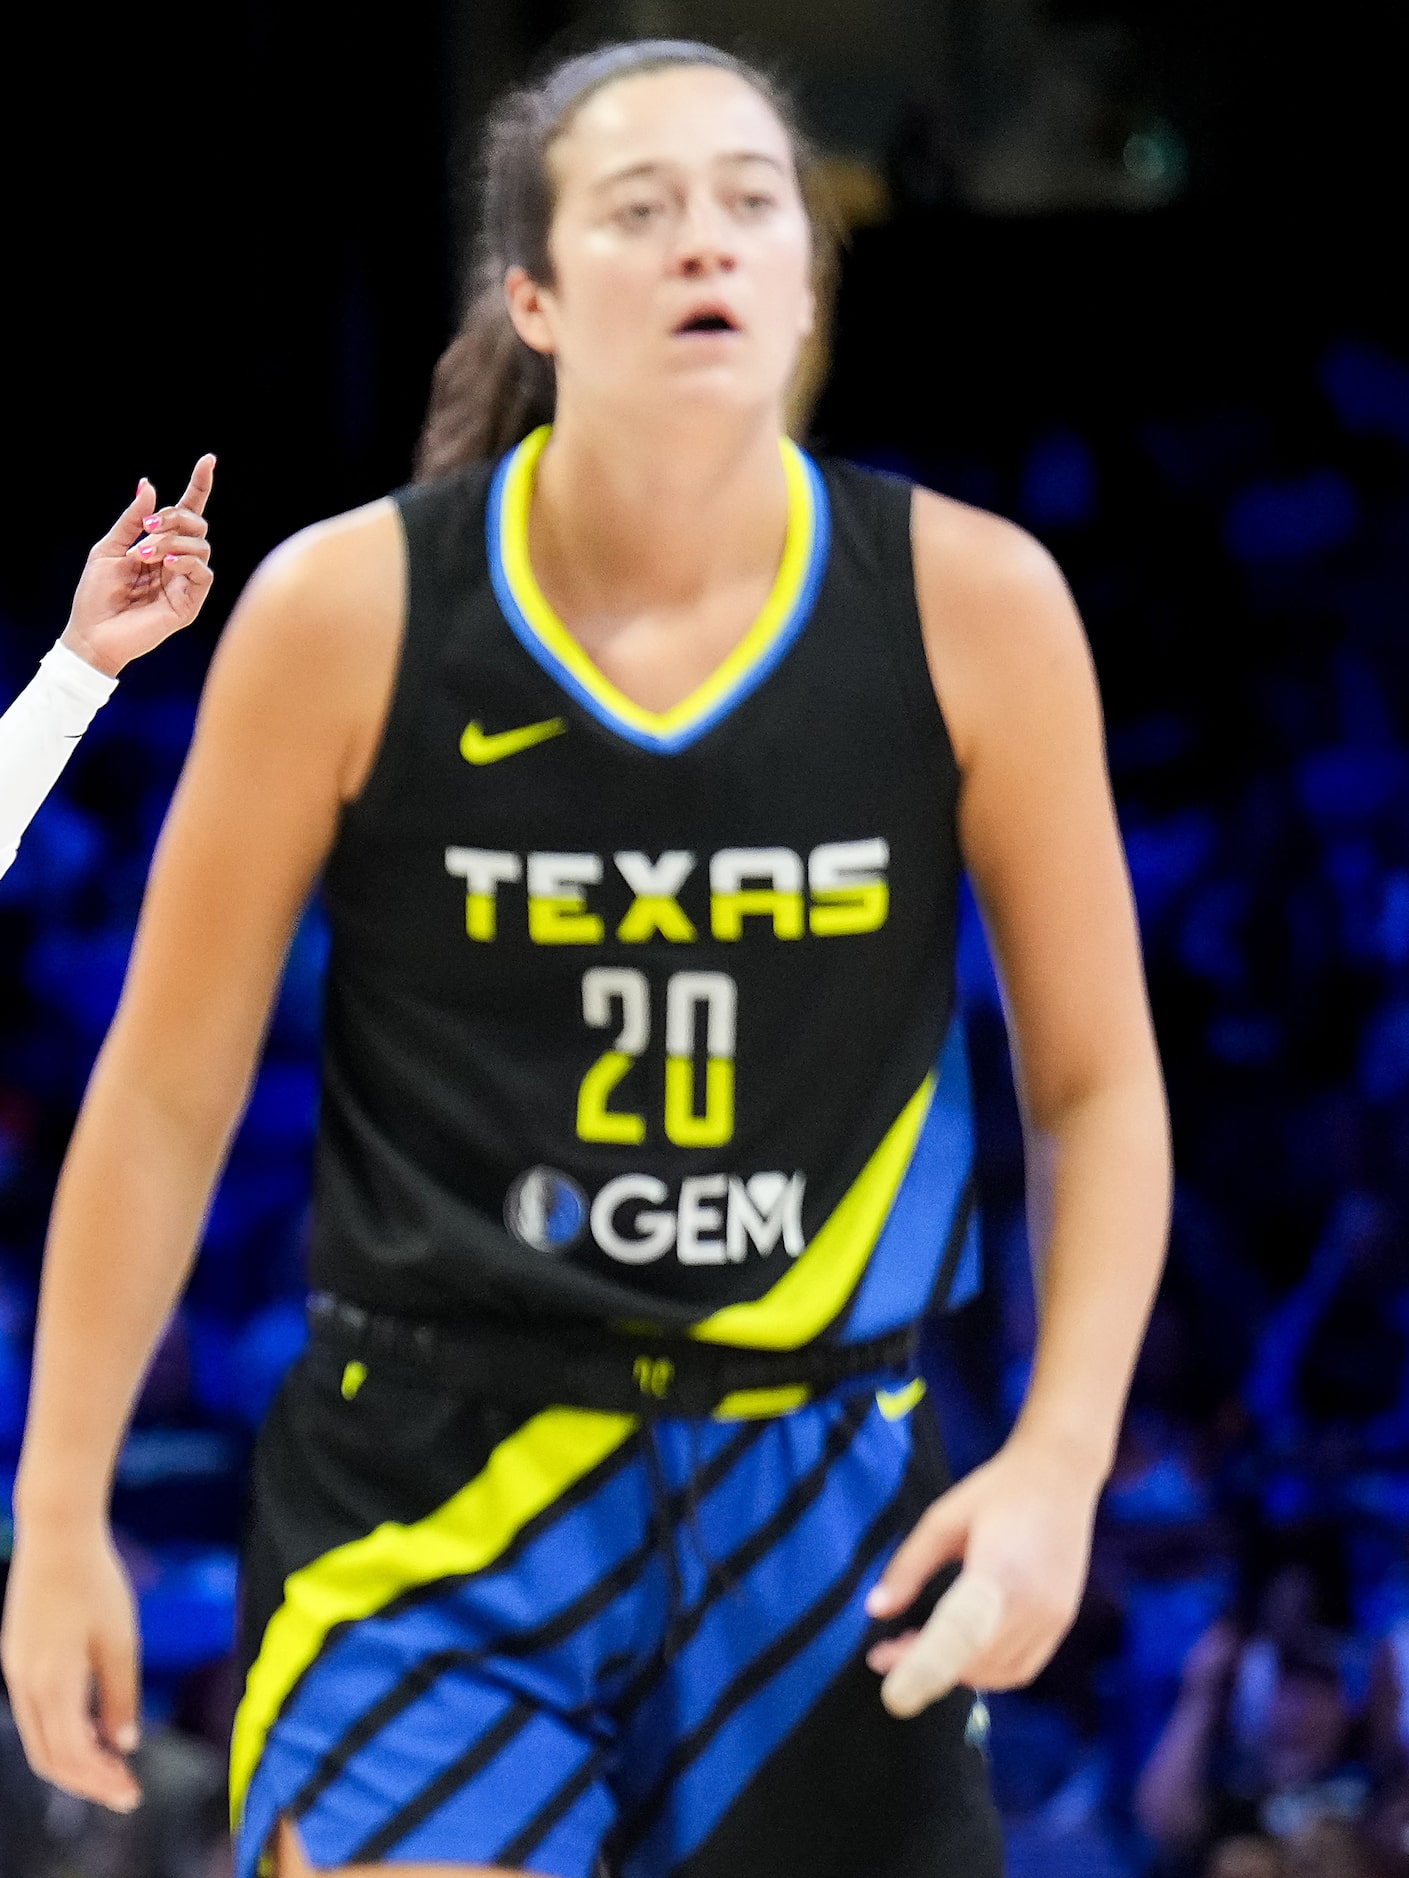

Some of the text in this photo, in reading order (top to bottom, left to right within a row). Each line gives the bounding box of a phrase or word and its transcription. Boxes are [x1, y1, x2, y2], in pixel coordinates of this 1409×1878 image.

[444, 836, 890, 945] TEXAS
[576, 966, 738, 1149] 20
[590, 1169, 807, 1266] GEM
